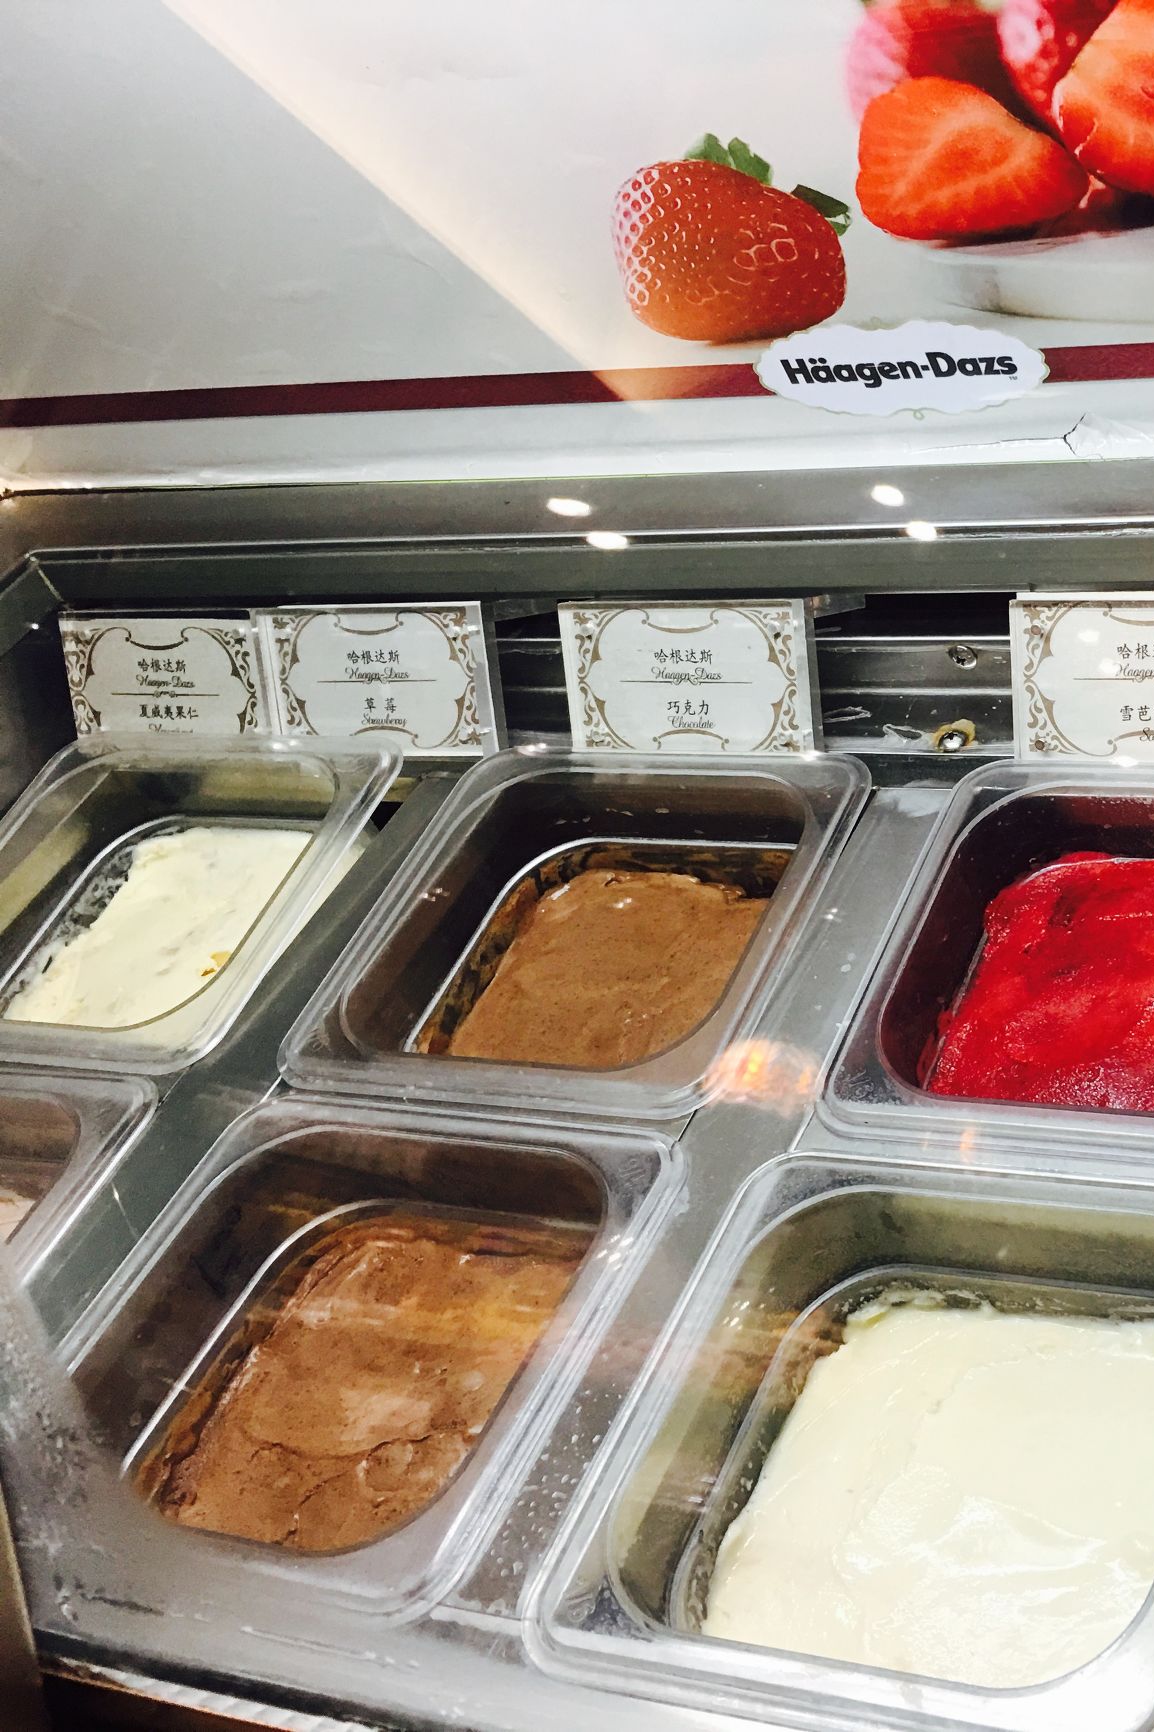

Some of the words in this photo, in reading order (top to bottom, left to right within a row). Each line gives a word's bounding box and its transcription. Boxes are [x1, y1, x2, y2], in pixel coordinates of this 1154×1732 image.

[780, 351, 1018, 388] Häagen-Dazs
[347, 649, 400, 664] 哈根达斯
[654, 648, 712, 665] 哈根达斯
[138, 658, 186, 674] 哈根达斯
[139, 704, 199, 720] 夏威夷果仁
[364, 697, 397, 713] 草莓
[667, 699, 709, 716] 巧克力
[667, 715, 715, 729] Chocolate
